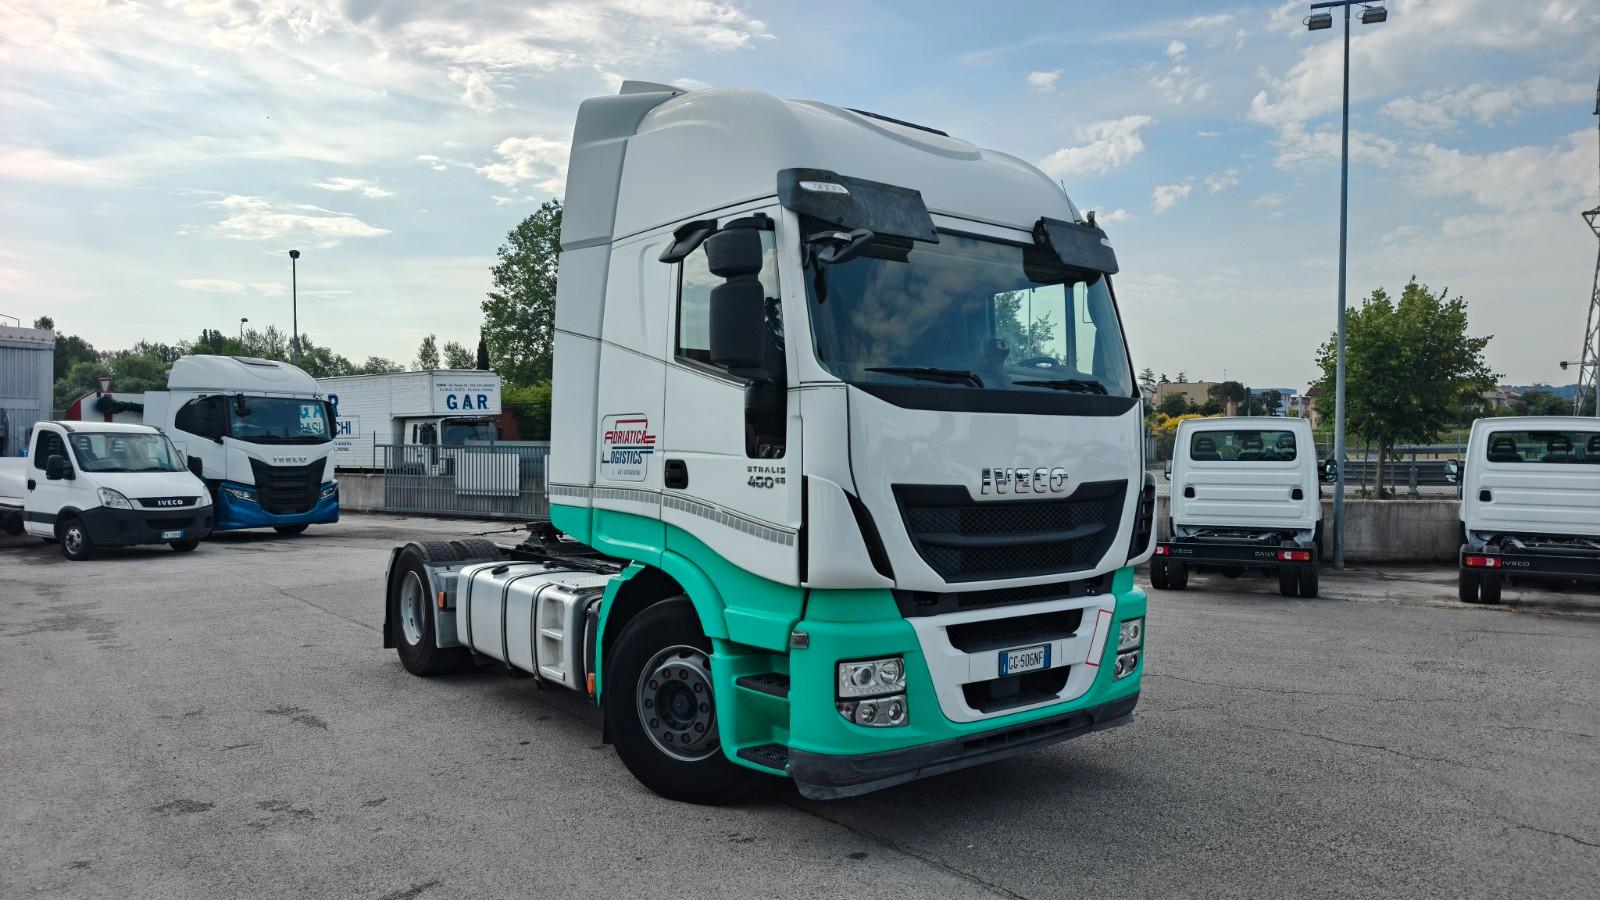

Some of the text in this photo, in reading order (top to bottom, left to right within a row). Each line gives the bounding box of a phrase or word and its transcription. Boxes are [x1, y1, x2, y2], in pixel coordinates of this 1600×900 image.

[604, 430, 655, 445] ADRIATICA
[602, 450, 644, 464] LOGISTICS
[747, 466, 786, 474] STRALIS
[981, 466, 1069, 495] IVECO
